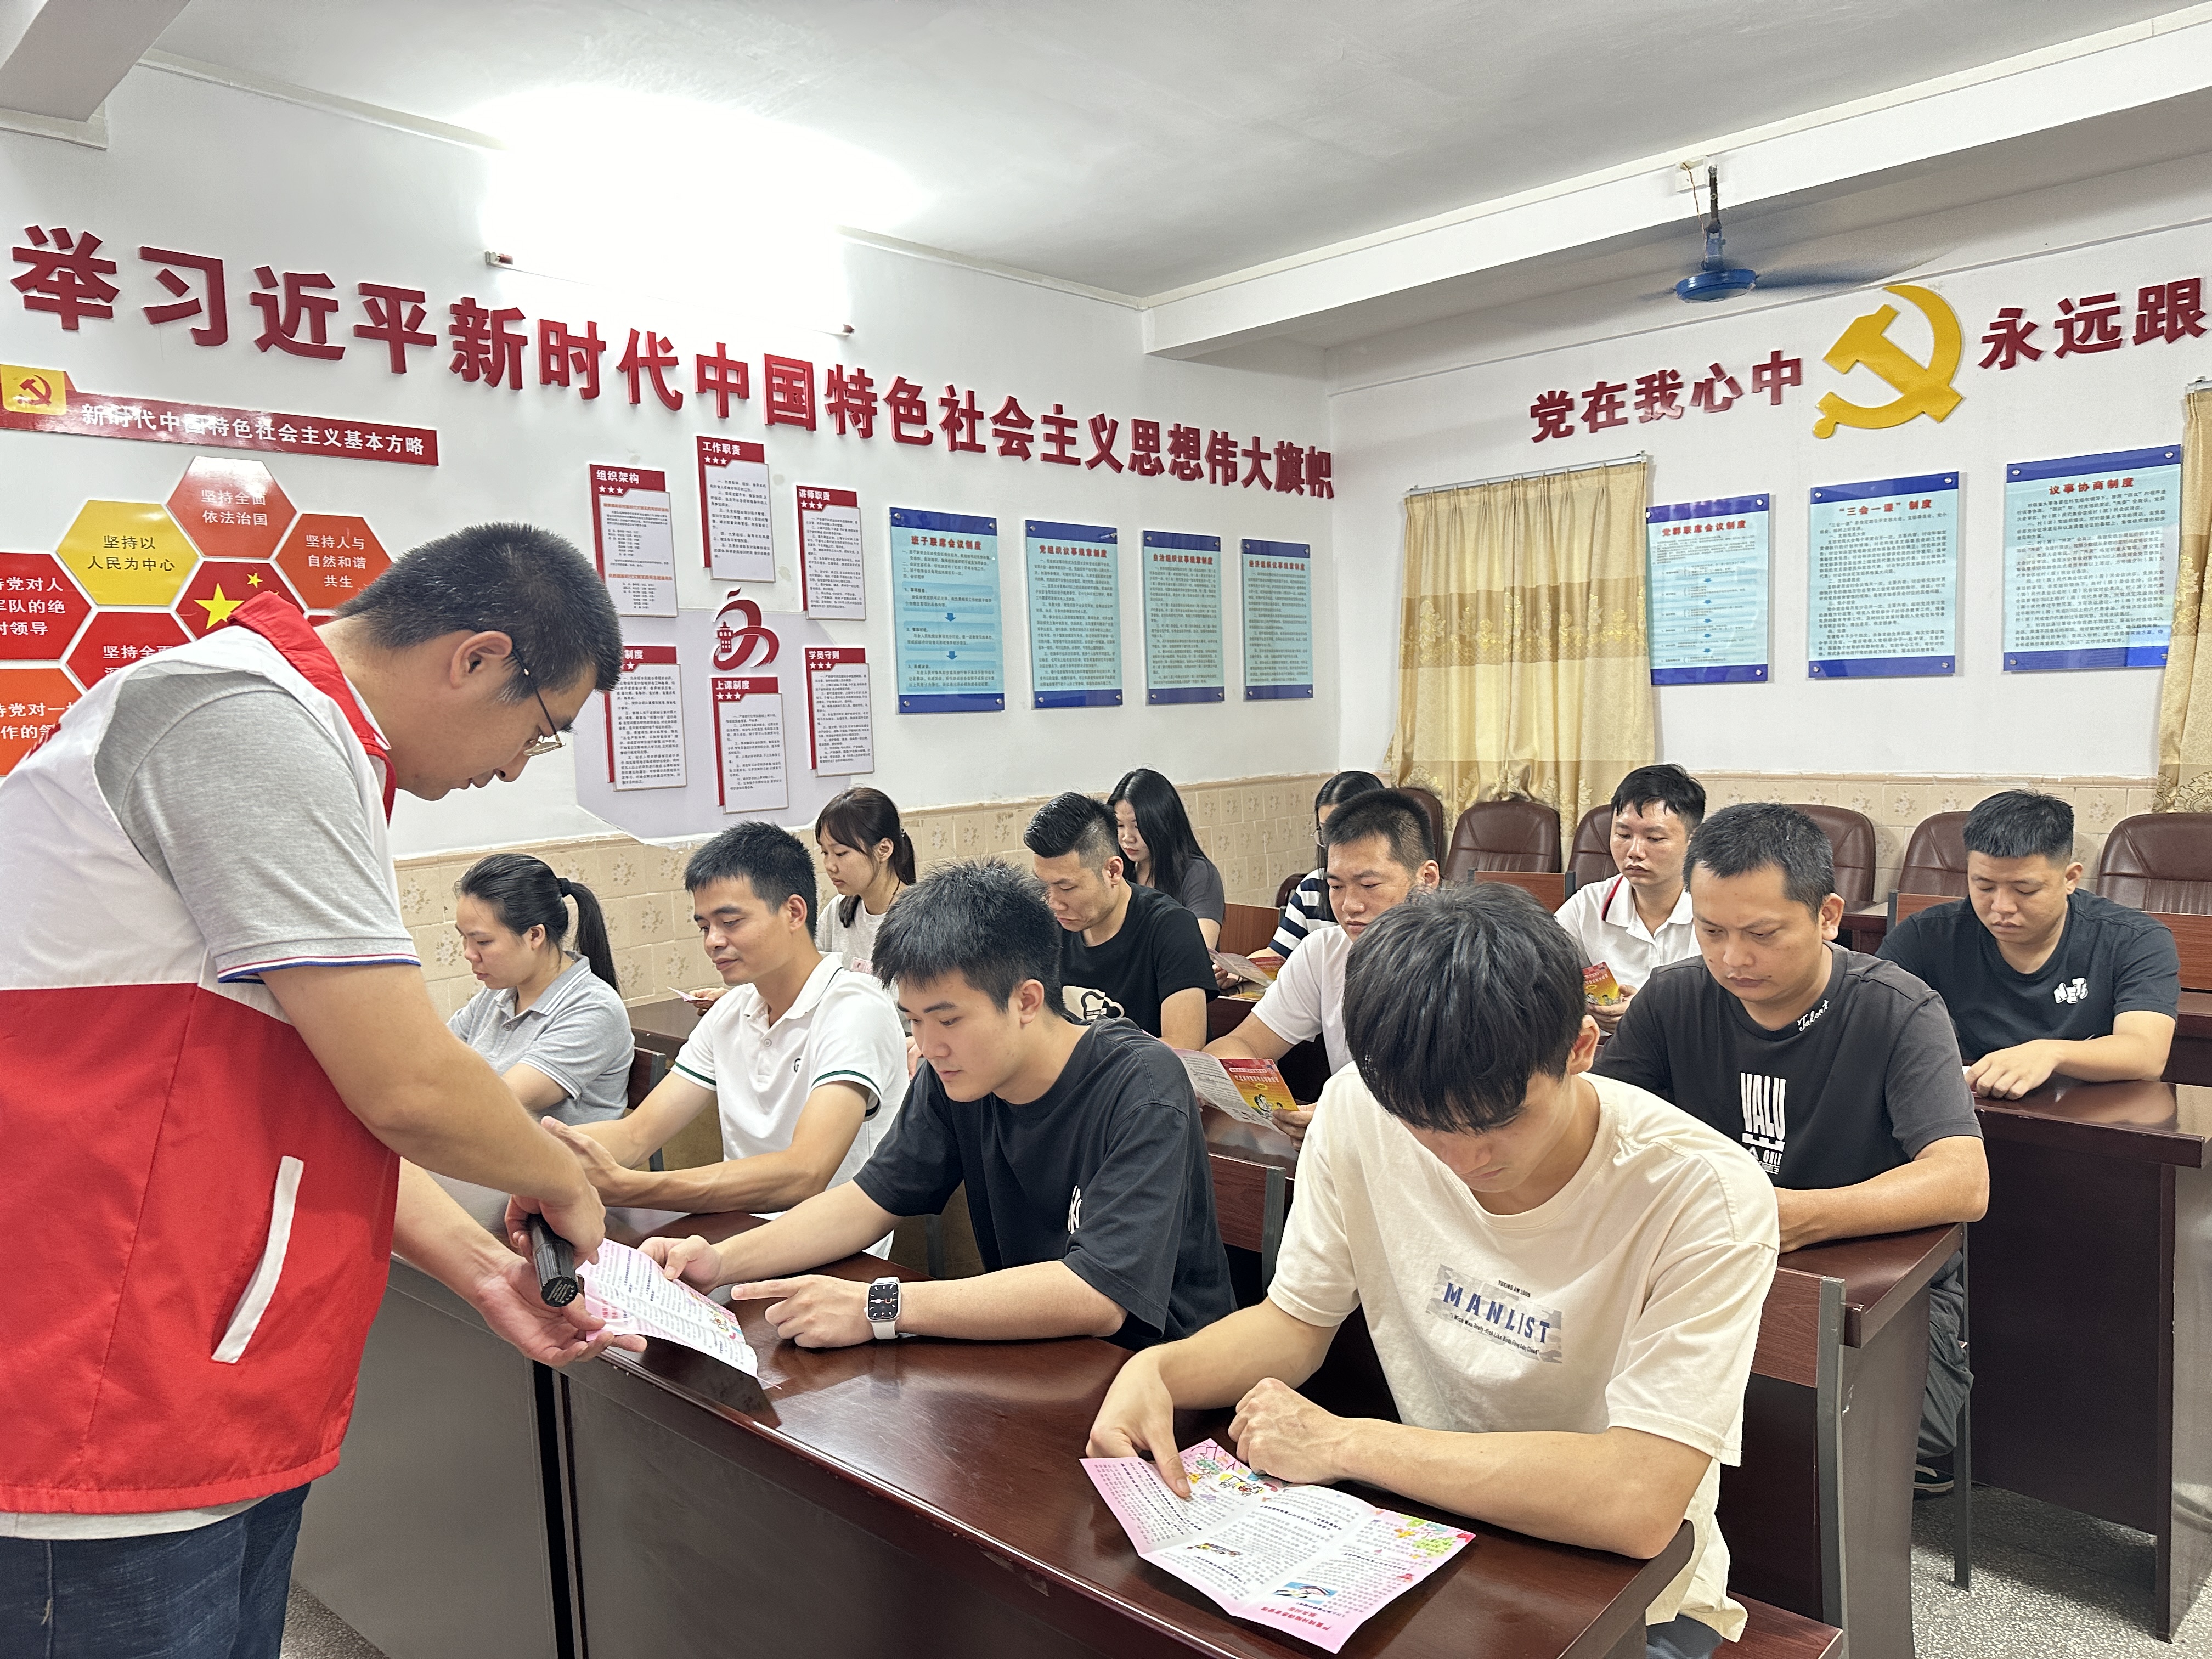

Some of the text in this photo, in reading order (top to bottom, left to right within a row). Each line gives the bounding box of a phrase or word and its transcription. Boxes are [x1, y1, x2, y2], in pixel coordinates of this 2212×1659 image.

[10, 225, 1334, 500] 举习近平新时代中国特色社会主义思想伟大旗帜
[1530, 277, 2210, 442] 党在我心中 永远跟
[81, 403, 425, 456] 新时代中国特色社会主义基本方略
[703, 441, 741, 456] 工作职责
[596, 470, 639, 484] 组织架构
[2049, 477, 2134, 495] 议事协商制度
[201, 489, 267, 506] 坚持全面
[799, 489, 830, 501] 讲师职责
[202, 510, 268, 526] 依法治国
[1662, 520, 1746, 537] 党群联席会议制度
[103, 535, 155, 550] 坚持以
[306, 535, 365, 550] 坚持人与
[911, 535, 981, 551] 班子联席会议制度
[87, 556, 176, 572] 人民为中心
[308, 555, 367, 570] 自然和谐
[0, 577, 64, 592] 党对人
[324, 575, 353, 589] 共生
[103, 645, 173, 659] 坚持全
[809, 651, 840, 659] 学员守则
[715, 680, 750, 690] 上课制度
[1443, 1282, 1550, 1343] MANLIST
